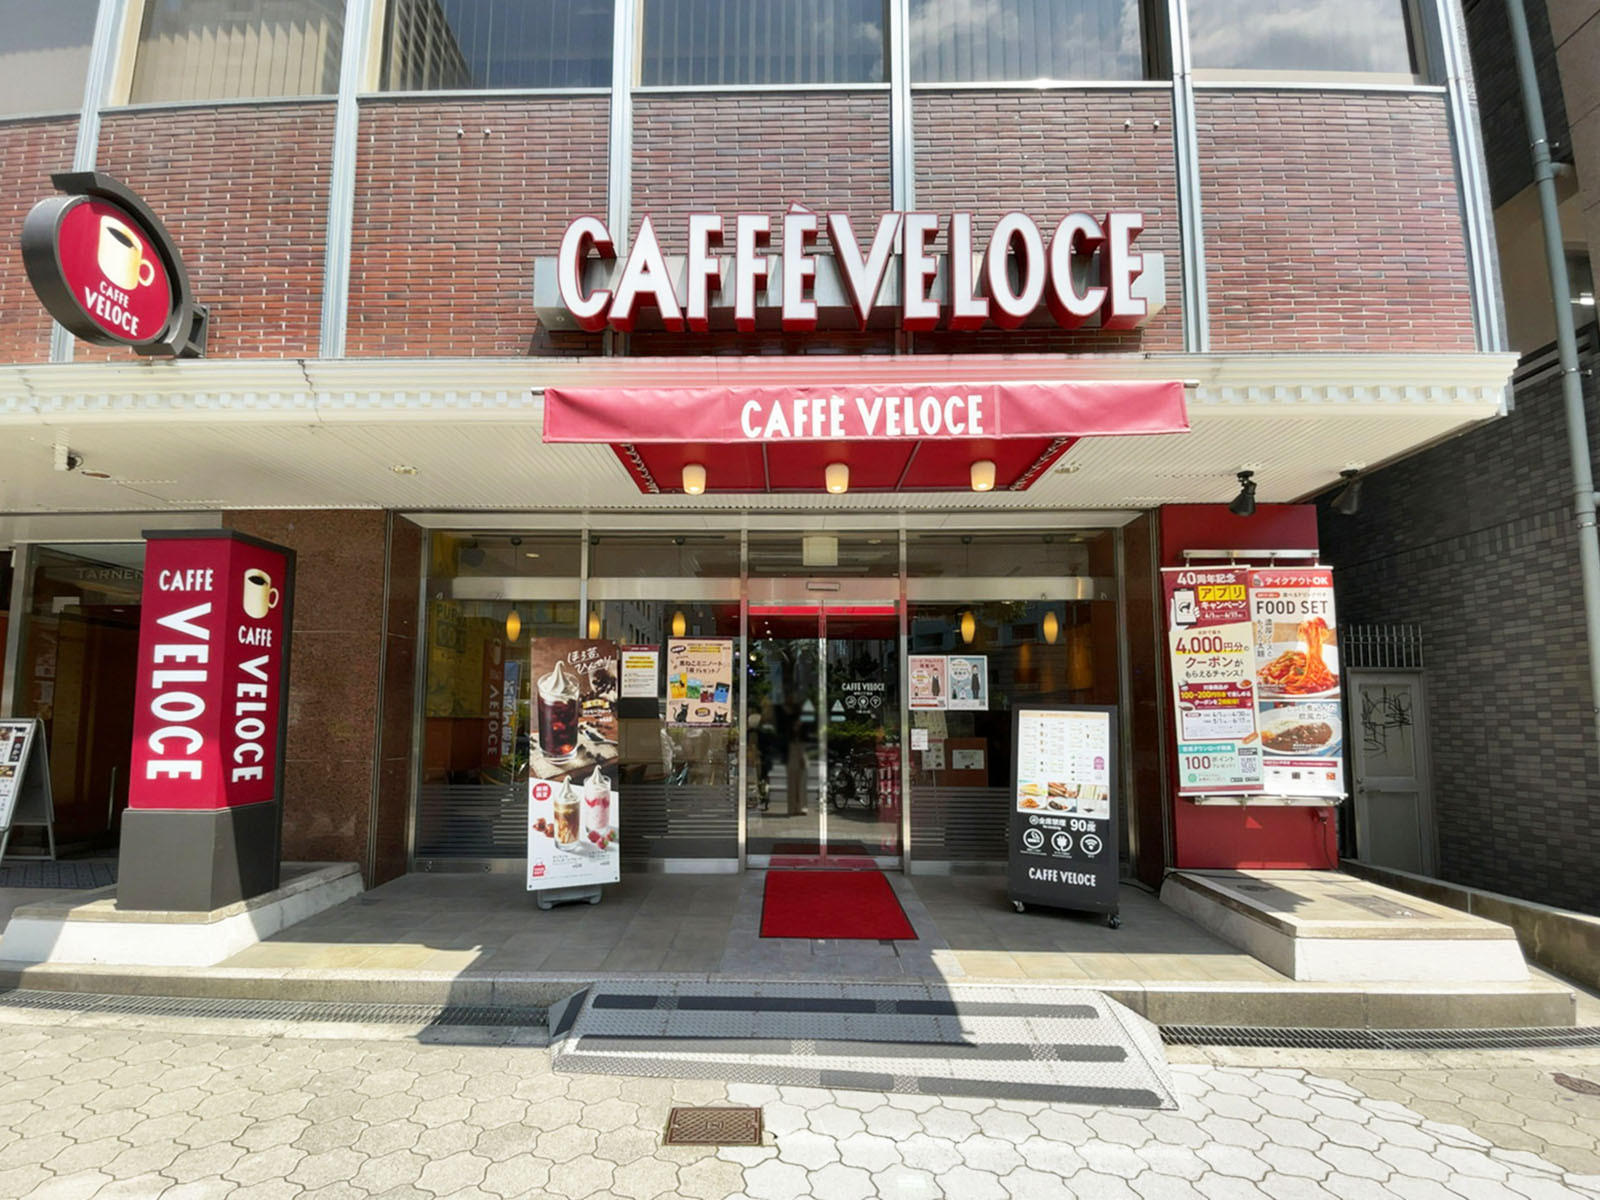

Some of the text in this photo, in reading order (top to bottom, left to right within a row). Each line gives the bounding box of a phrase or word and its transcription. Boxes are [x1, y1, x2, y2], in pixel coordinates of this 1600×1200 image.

[558, 200, 1148, 325] CAFFÈ VELOCE
[85, 286, 140, 336] VELOCE
[856, 394, 984, 436] VELOCE
[1200, 586, 1242, 600] アプリ
[1201, 601, 1246, 610] キャンペーン
[1256, 600, 1296, 615] FOOD
[1300, 600, 1329, 614] SET
[1185, 656, 1244, 669] クーポンが
[146, 602, 212, 780] VELOCE
[231, 655, 270, 783] VELOCE
[1185, 755, 1211, 770] 100
[1060, 870, 1097, 887] VELOCE
